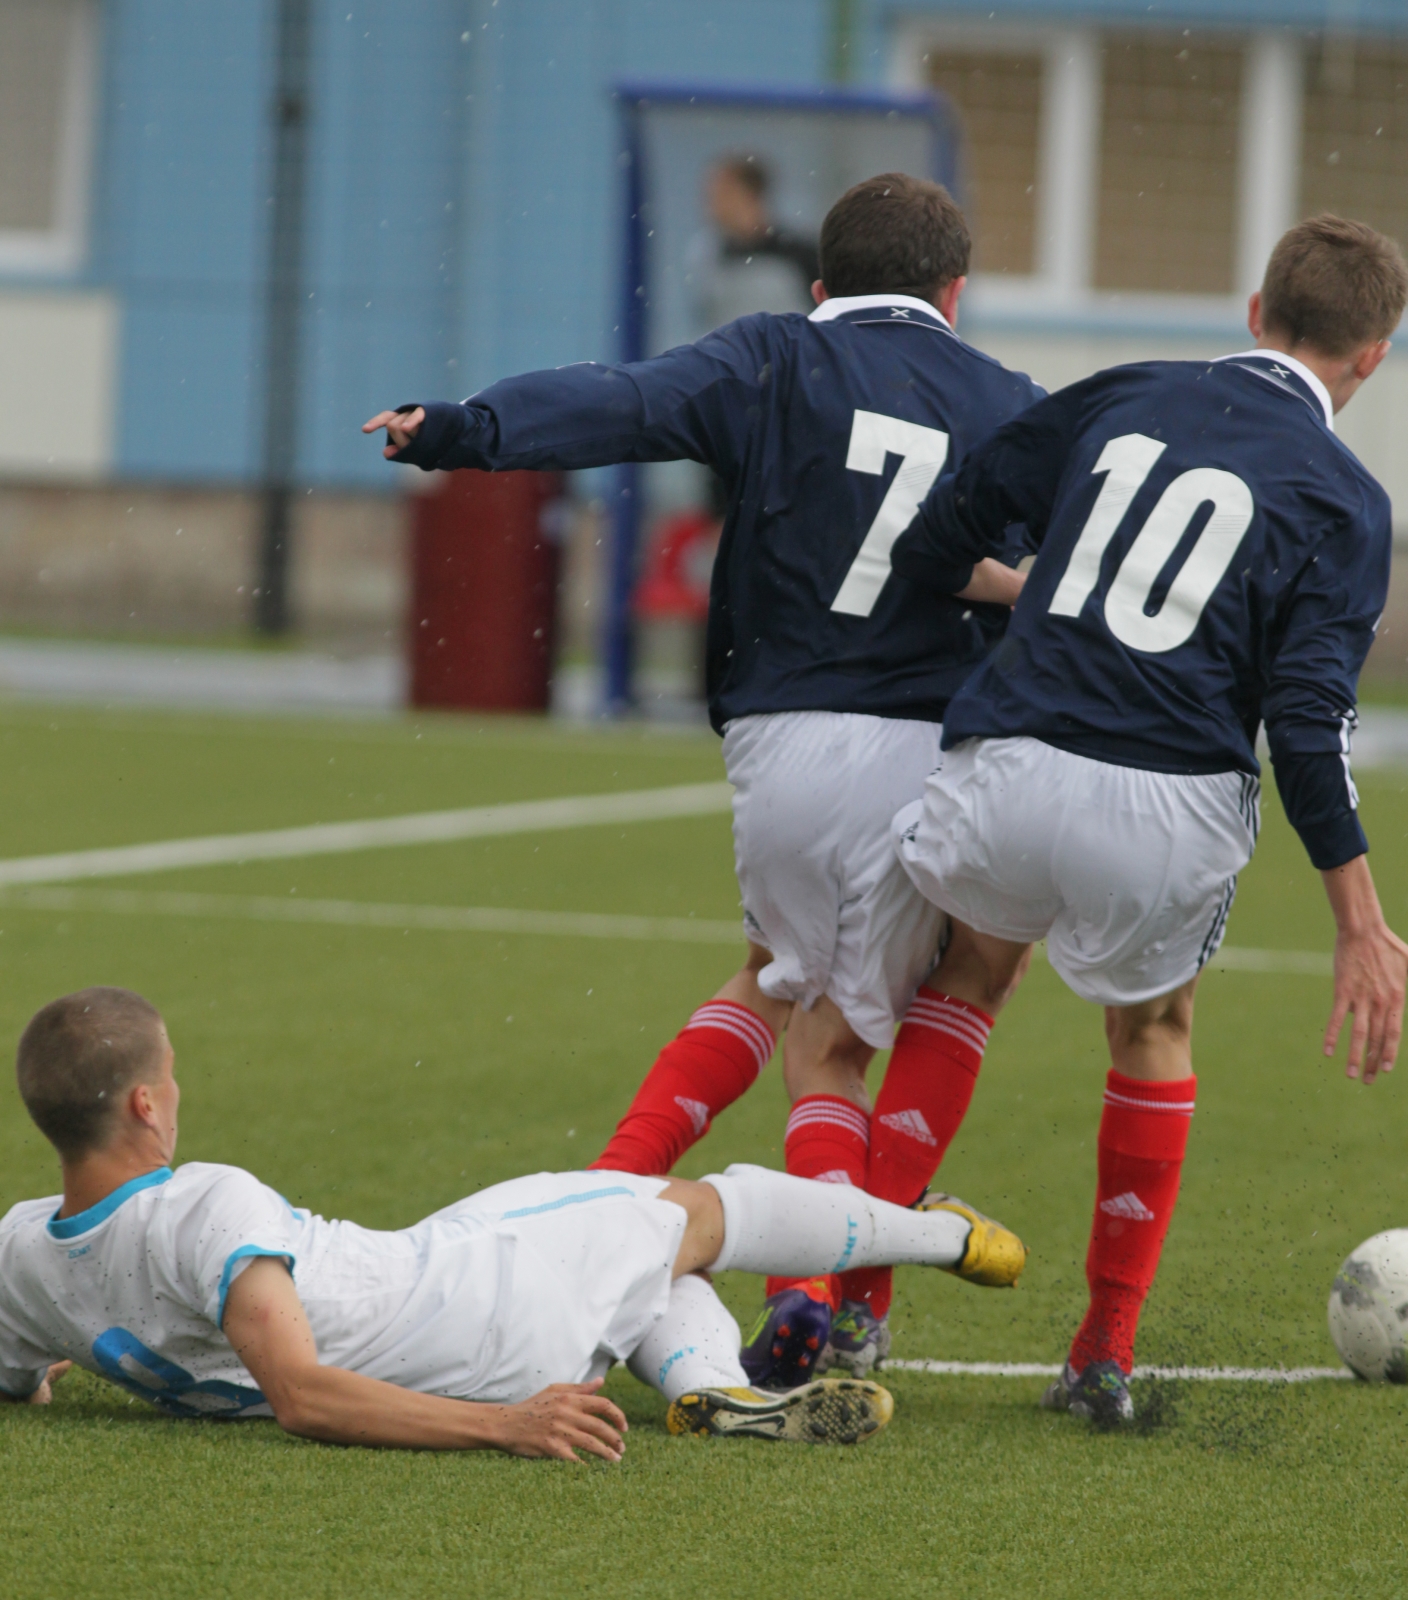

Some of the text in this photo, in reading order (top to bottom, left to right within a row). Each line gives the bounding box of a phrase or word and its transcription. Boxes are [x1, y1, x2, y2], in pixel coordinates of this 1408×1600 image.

[830, 409, 949, 617] 7
[1048, 433, 1254, 652] 10
[93, 1327, 267, 1415] 8
